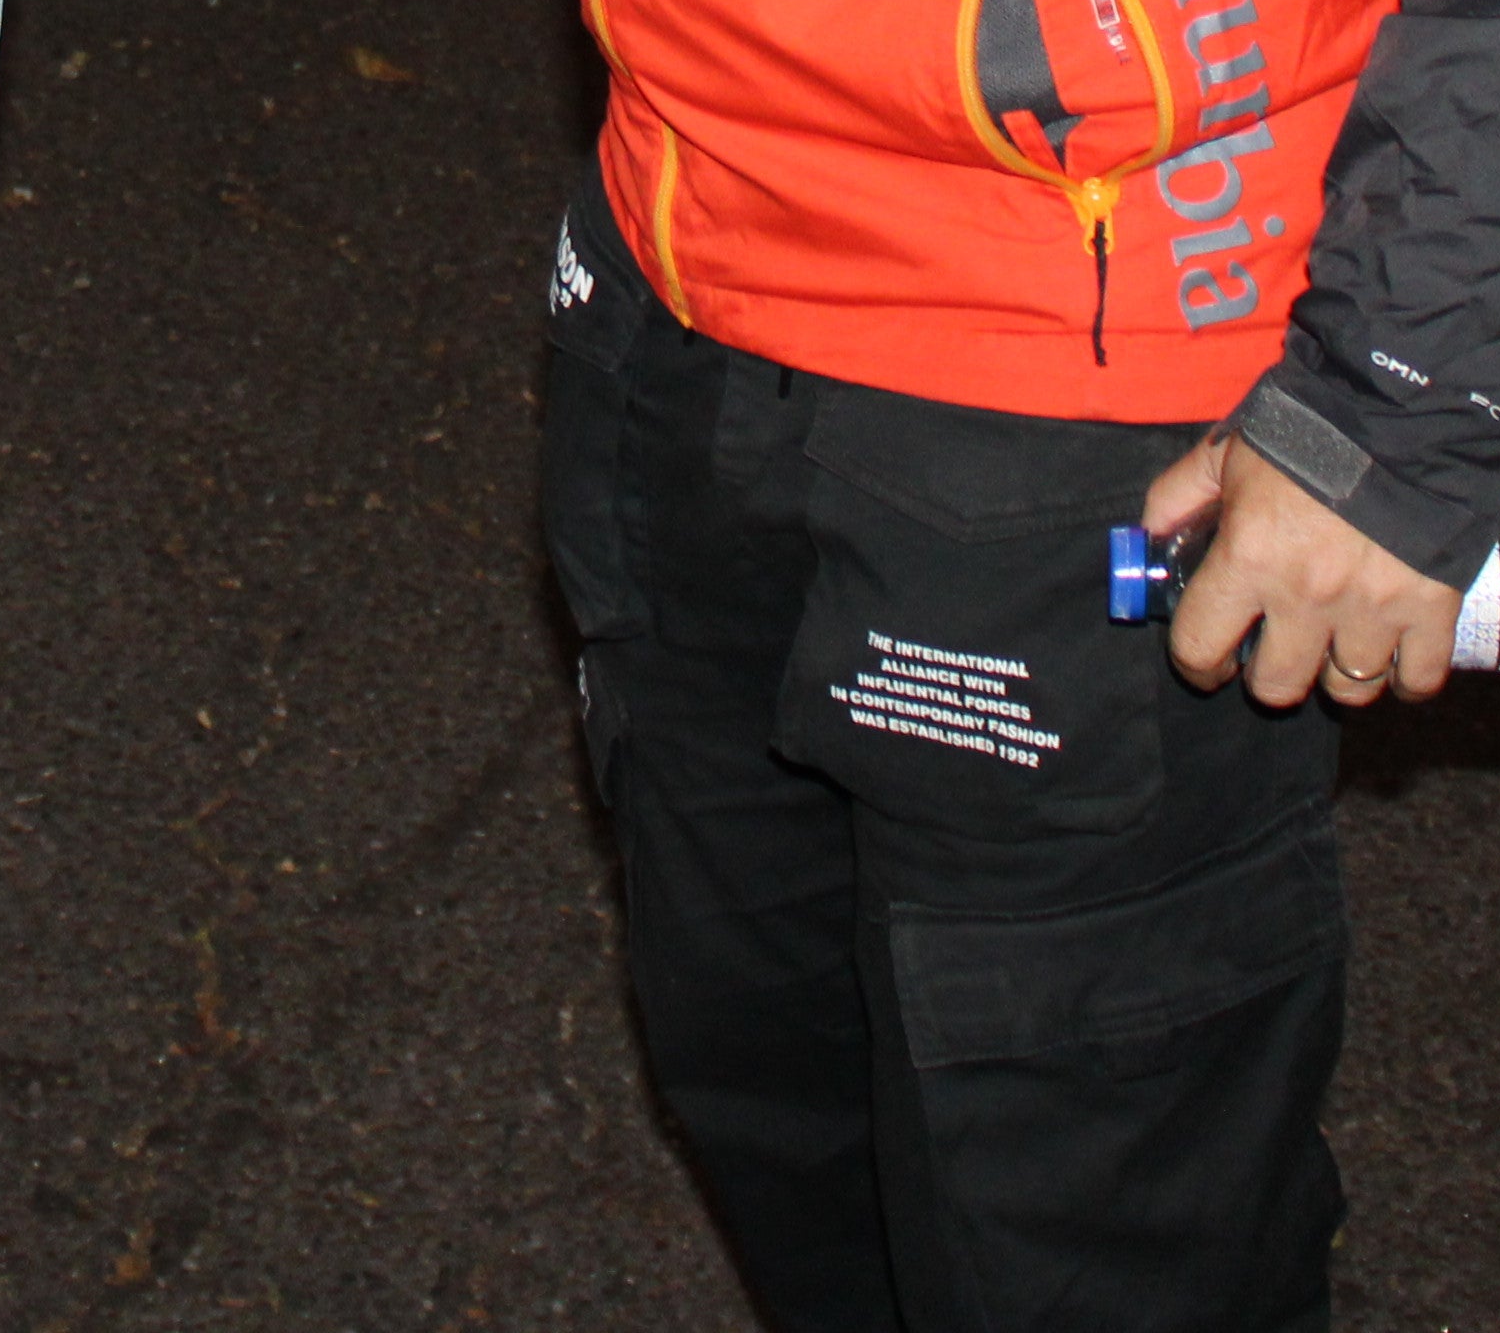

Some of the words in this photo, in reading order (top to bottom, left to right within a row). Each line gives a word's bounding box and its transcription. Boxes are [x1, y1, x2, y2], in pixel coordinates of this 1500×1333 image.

[867, 630, 893, 654] THE
[895, 640, 1030, 678] INTERNATIONAL
[881, 657, 961, 686] ALLIANCE
[962, 674, 1007, 696] WITH
[830, 685, 847, 703] IN
[849, 689, 985, 731] CONTEMPORARY
[987, 719, 1061, 750] FASHION
[857, 672, 963, 707] INFLUENTIAL
[964, 694, 1032, 721] FORCES
[850, 708, 887, 729] WAS
[888, 715, 996, 754] ESTABLISHED
[999, 744, 1040, 768] 1992
